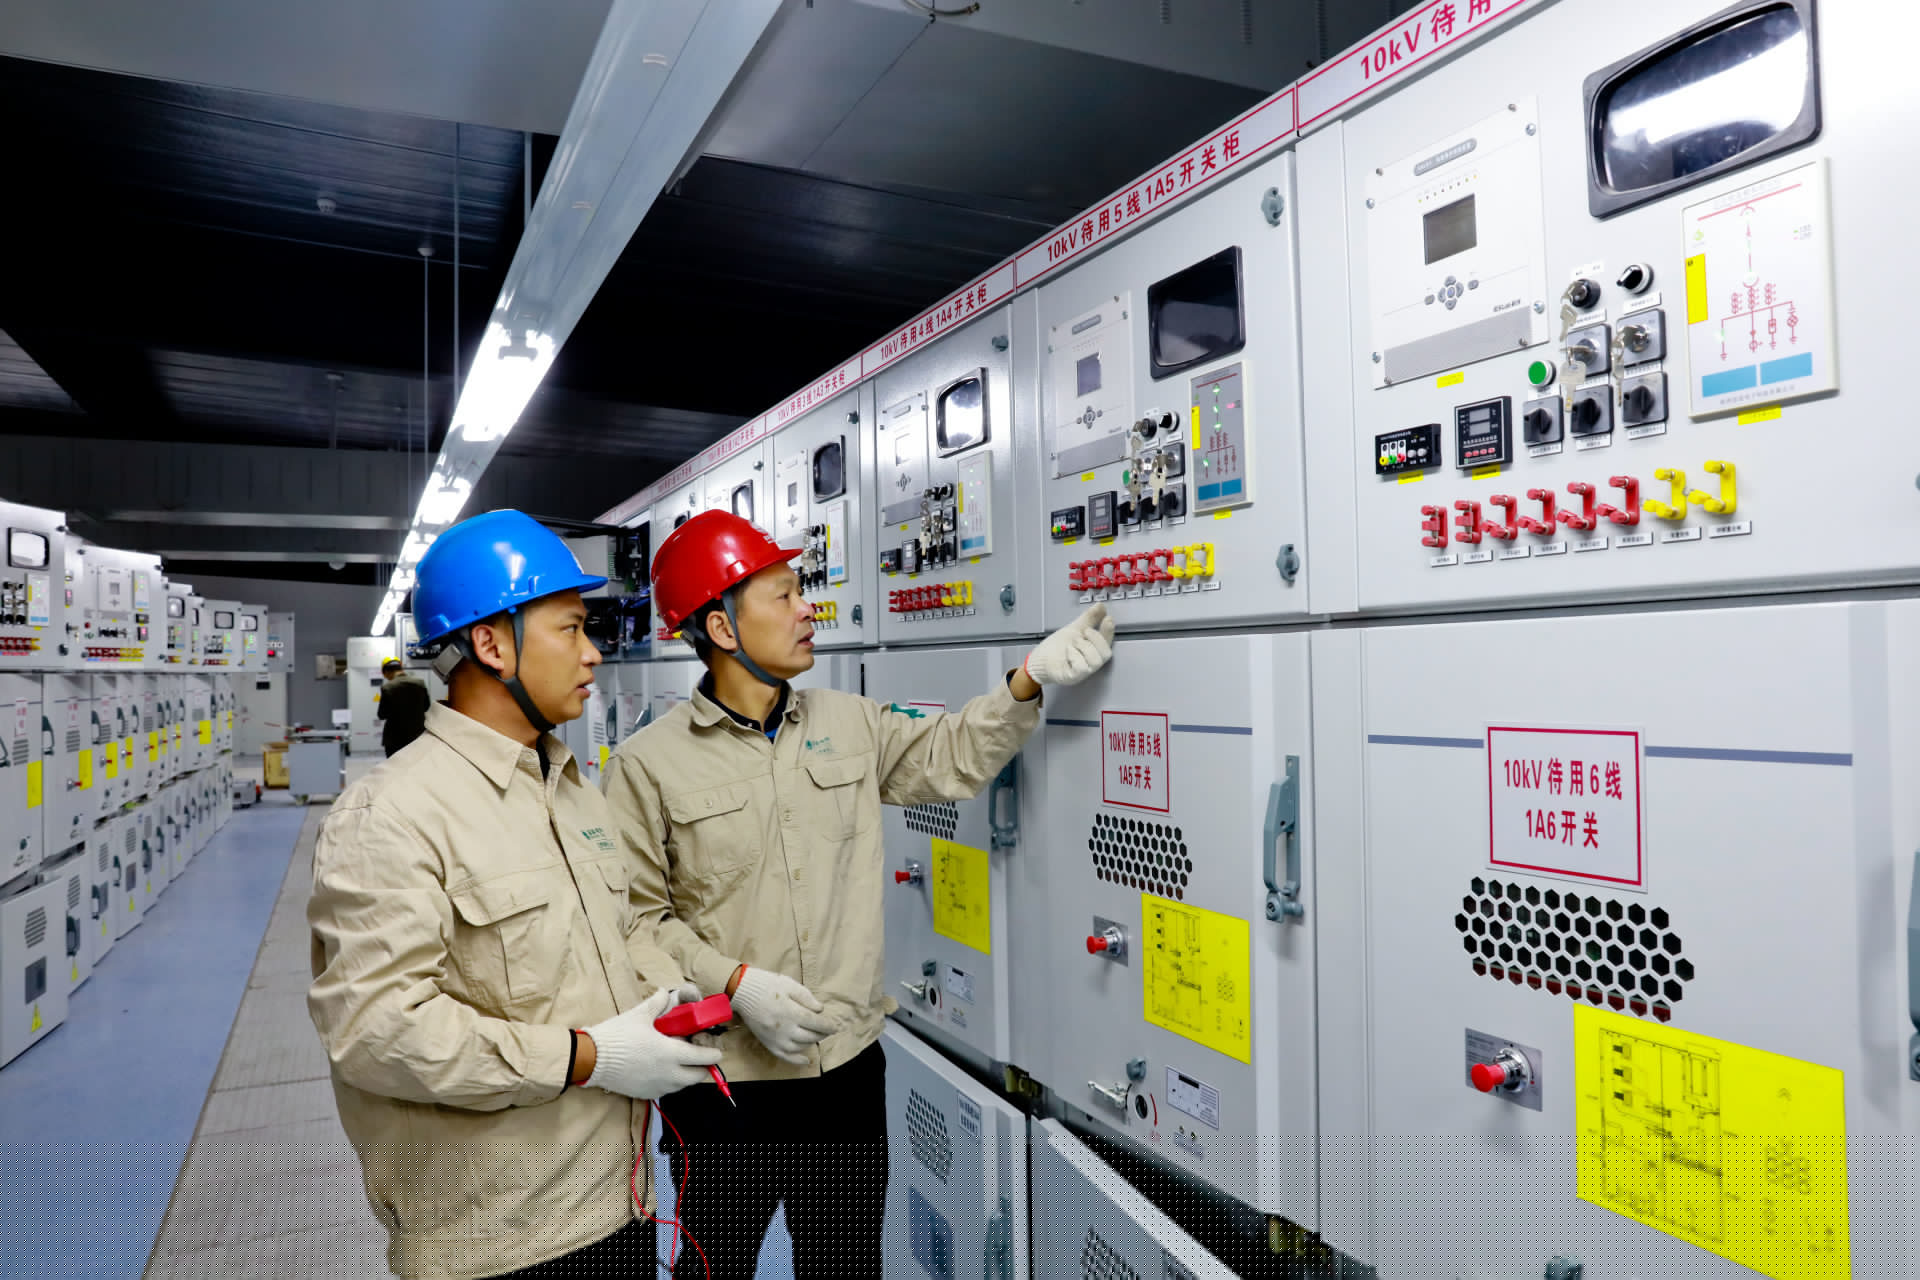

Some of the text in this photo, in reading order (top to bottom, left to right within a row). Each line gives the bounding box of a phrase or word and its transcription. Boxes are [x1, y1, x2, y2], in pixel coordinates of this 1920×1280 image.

[1047, 129, 1241, 262] 10kV待用5线1A5开关柜
[880, 282, 987, 360] 10kV待用4线1A4开关柜
[1108, 731, 1162, 759] 10kV待用5线
[1118, 764, 1152, 790] 1A5开关
[1504, 757, 1623, 801] 10kV待用6线
[1525, 808, 1599, 849] 1A6开关
